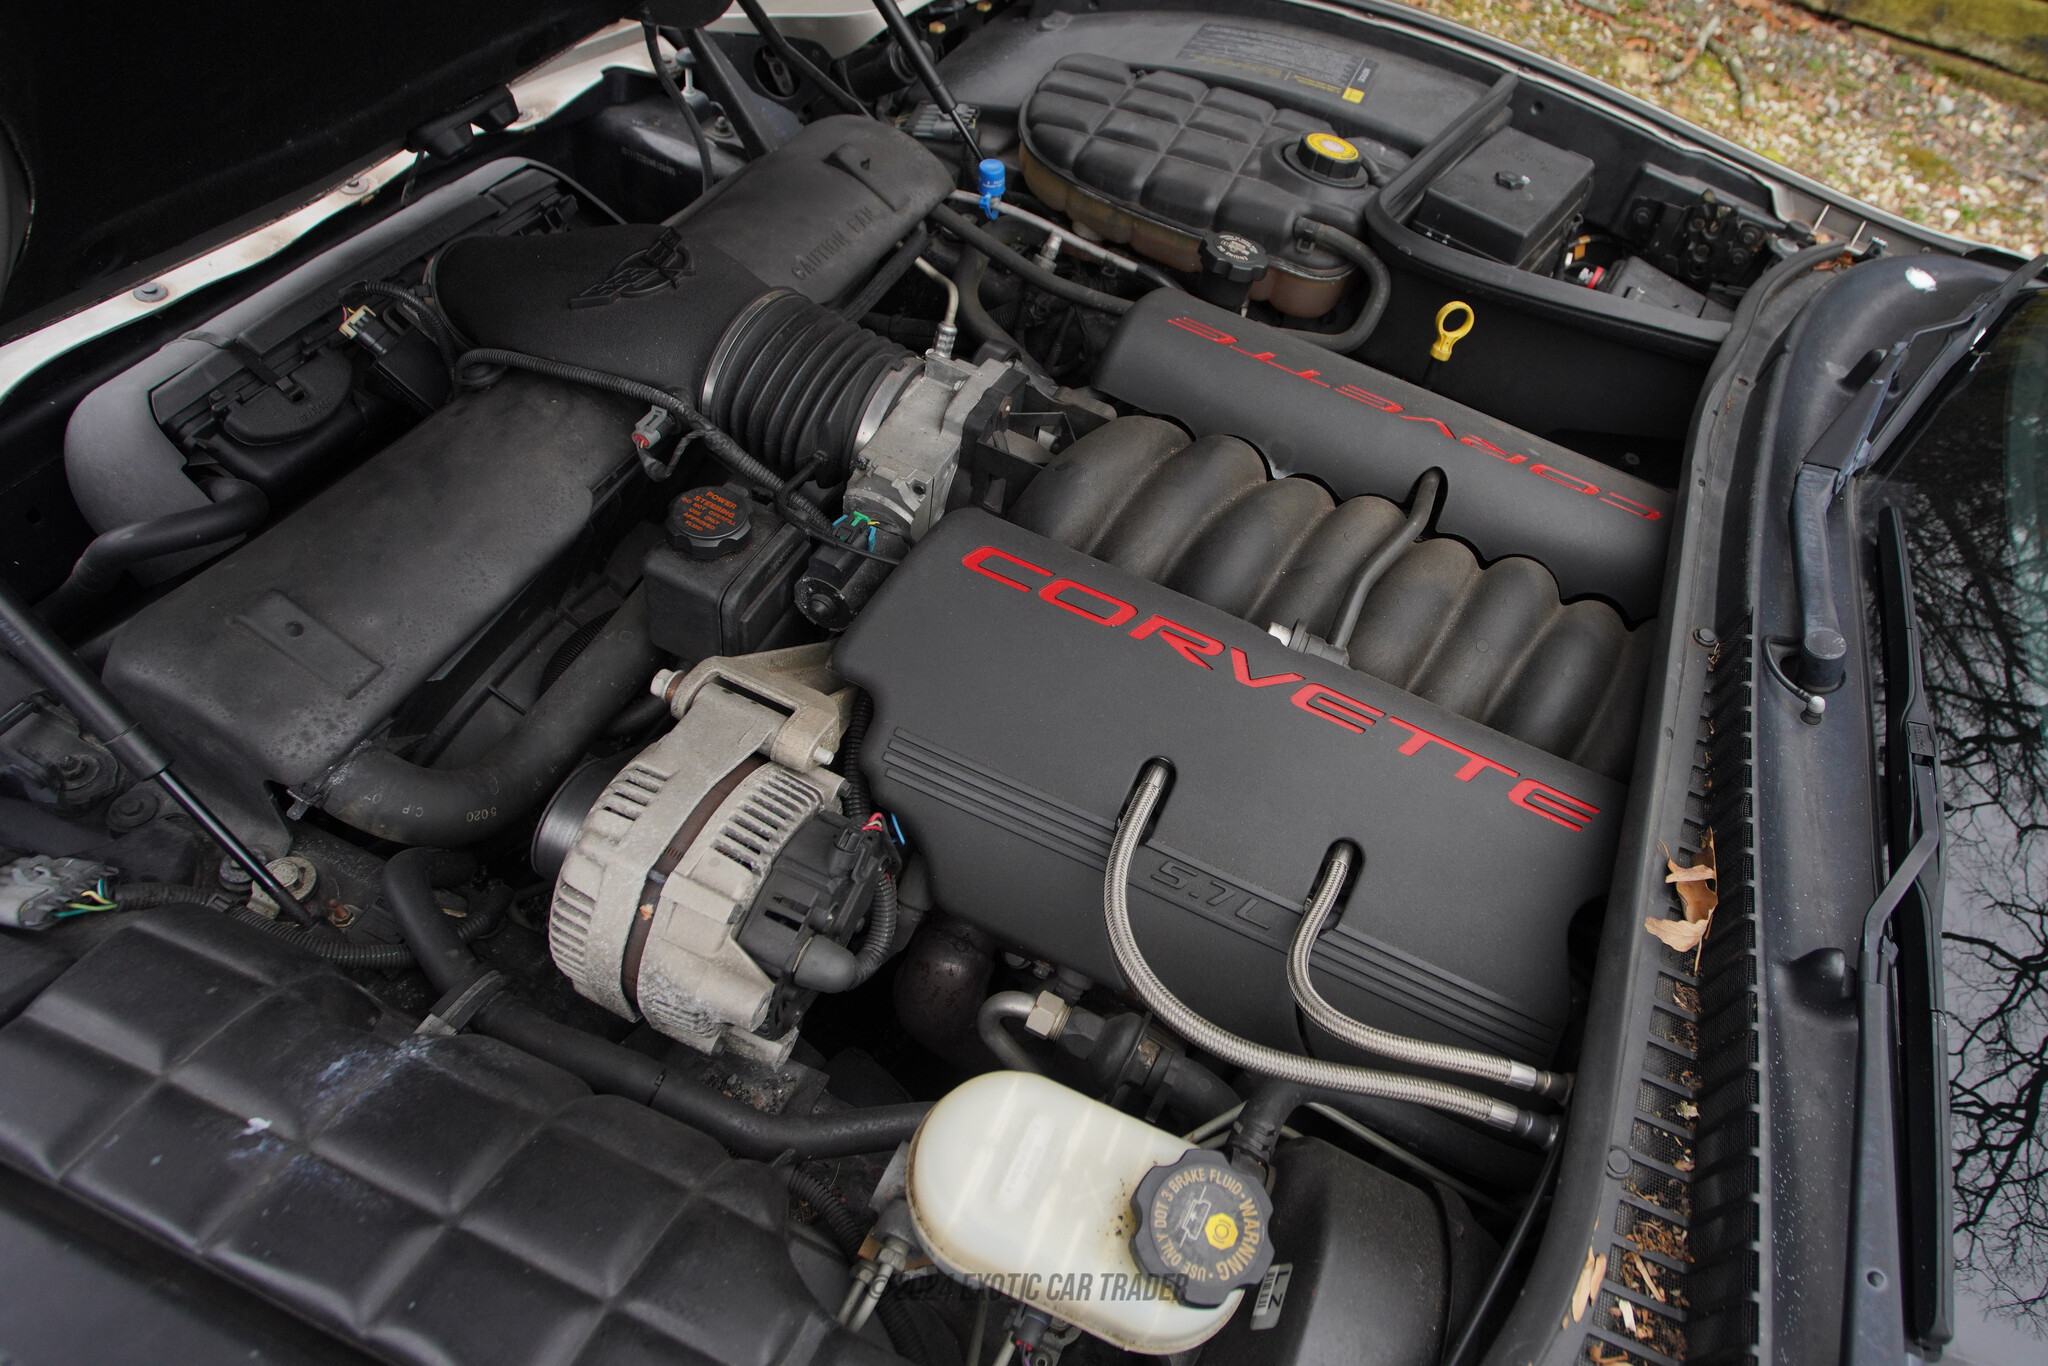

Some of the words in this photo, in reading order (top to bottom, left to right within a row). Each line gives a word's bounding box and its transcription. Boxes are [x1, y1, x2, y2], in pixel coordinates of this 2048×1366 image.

[790, 230, 851, 281] CAUTION
[1167, 317, 1662, 521] CORVETTE
[681, 496, 692, 504] DO
[693, 502, 706, 511] NOT
[709, 510, 736, 527] OVERFILL
[694, 495, 735, 519] STEERING
[706, 491, 737, 510] POWER
[683, 512, 716, 530] APPROVED
[685, 520, 703, 531] FLUID
[689, 508, 702, 516] USE
[704, 515, 720, 525] ONLY
[962, 546, 1602, 832] CORVETTE
[1150, 860, 1270, 930] 5.7L
[1168, 1168, 1206, 1193] BRAKE
[1209, 1168, 1243, 1196] FLUID
[1161, 1190, 1173, 1202] 3
[1154, 1201, 1169, 1229] DOT
[1156, 1233, 1183, 1267] ONLY
[1216, 1198, 1260, 1281] WARNING
[1182, 1261, 1205, 1282] USE
